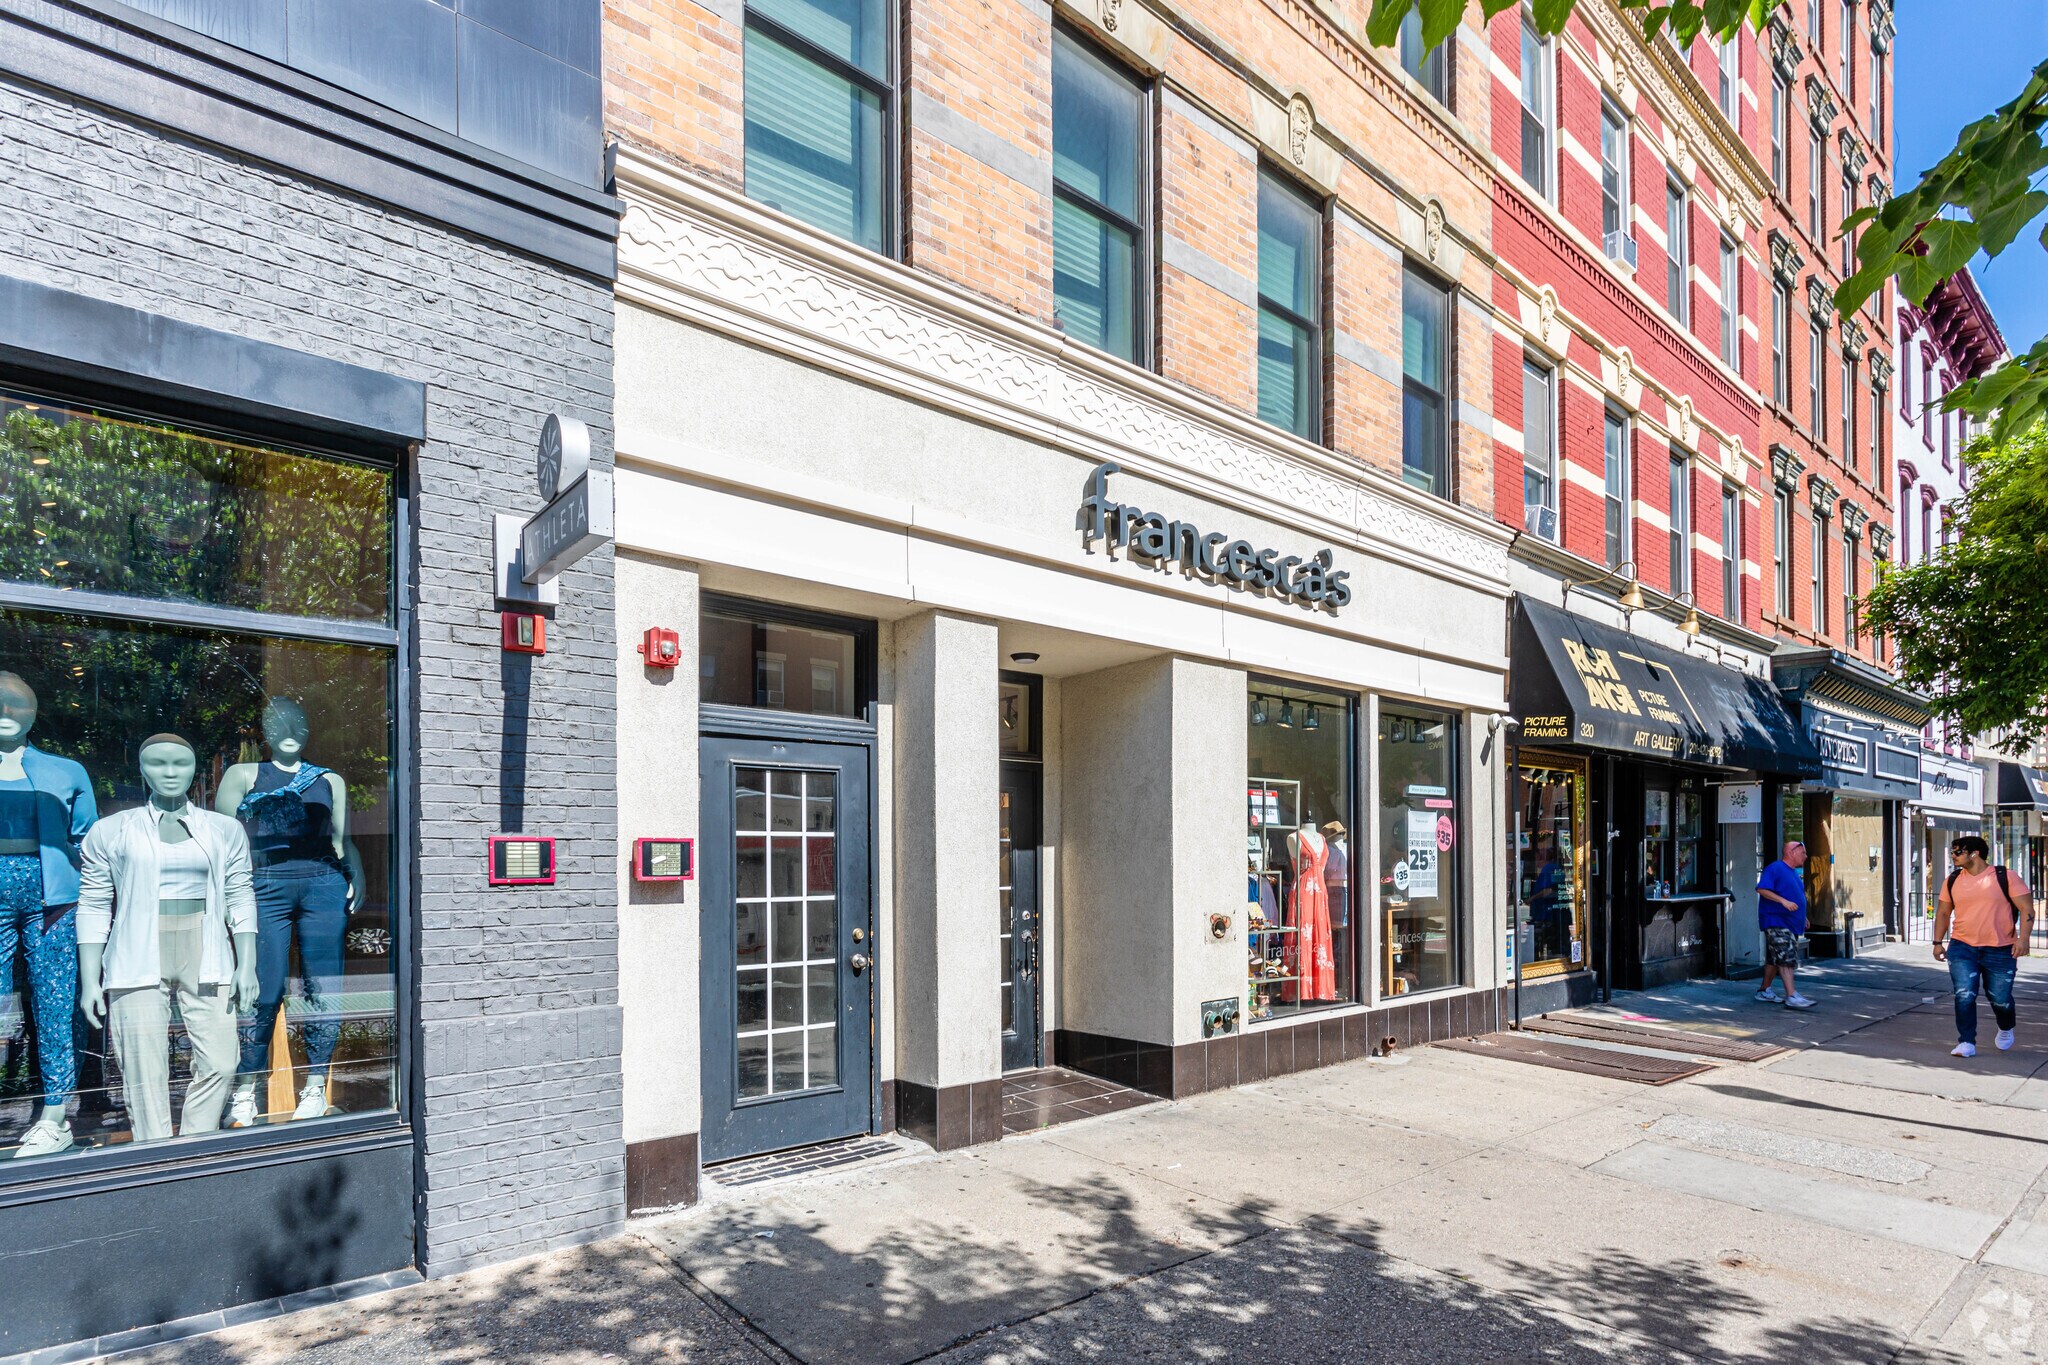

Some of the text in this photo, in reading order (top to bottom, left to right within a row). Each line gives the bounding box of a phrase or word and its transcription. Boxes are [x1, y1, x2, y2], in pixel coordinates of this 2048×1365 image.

[525, 495, 587, 566] ATHLETA
[1081, 461, 1351, 608] francesca's
[1561, 637, 1621, 681] RIGHT
[1585, 676, 1642, 716] ANGLE
[1637, 689, 1670, 708] PICTURE
[1523, 716, 1567, 726] PICTURE
[1647, 706, 1681, 725] FRAMING
[1523, 728, 1568, 737] FRAMING
[1580, 722, 1595, 738] 320
[1633, 730, 1650, 747] ART
[1651, 734, 1683, 752] GALLERY
[1409, 839, 1420, 847] ENTIRE
[1436, 829, 1451, 846] $35
[1395, 869, 1409, 881] $35
